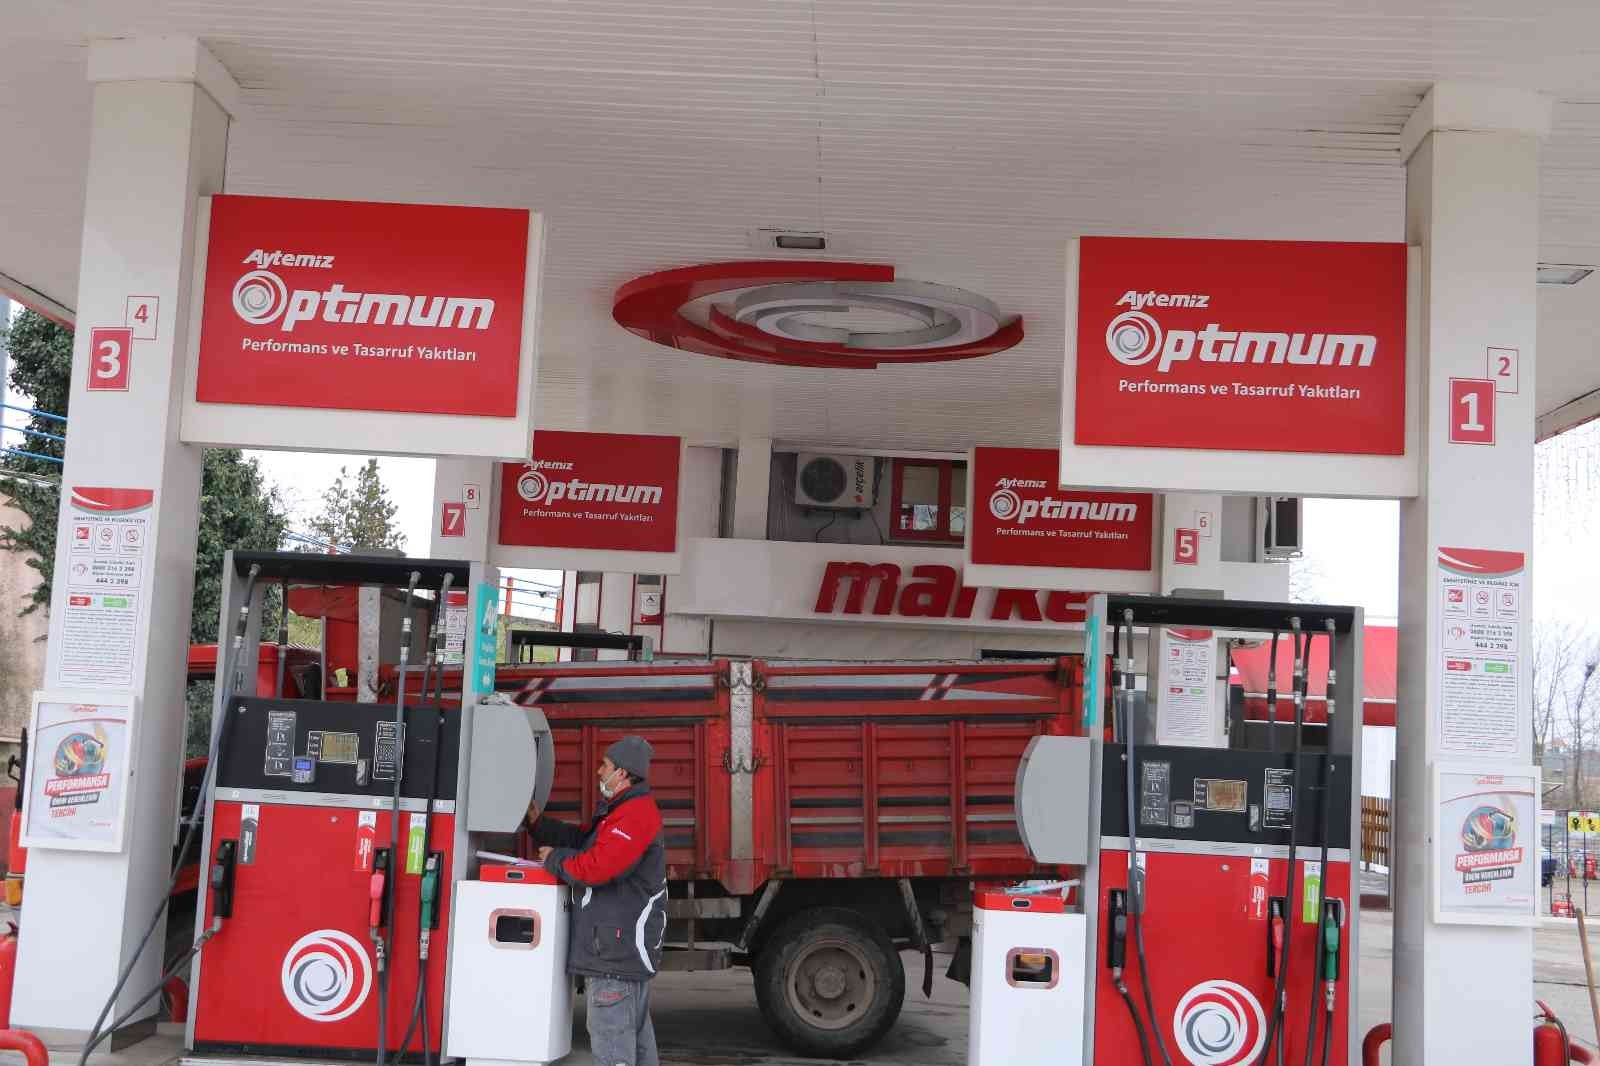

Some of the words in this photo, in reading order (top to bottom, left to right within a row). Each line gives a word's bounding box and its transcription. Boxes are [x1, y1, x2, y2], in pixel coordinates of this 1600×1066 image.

[242, 248, 335, 270] Aytemiz
[232, 270, 495, 332] Optimum
[1115, 290, 1210, 310] Aytemiz
[134, 304, 148, 323] 4
[242, 338, 328, 354] Performans
[332, 346, 349, 355] ve
[353, 343, 414, 358] Tasarruf
[417, 346, 477, 361] Yakıtları
[1106, 311, 1377, 373] Optimum
[96, 340, 121, 379] 3
[1498, 356, 1511, 376] 2
[1119, 380, 1206, 394] Performans
[1211, 385, 1229, 395] ve
[1232, 383, 1295, 397] Tasarruf
[1298, 384, 1360, 399] Yakıtları
[1461, 392, 1485, 431] 1
[467, 489, 475, 500] 8
[517, 470, 663, 505] Optimum
[523, 508, 570, 518] Performans
[585, 511, 617, 521] Tasarruf
[989, 489, 1138, 523] Optimum
[447, 509, 461, 530] 7
[1199, 516, 1207, 528] 6
[996, 527, 1045, 537] Performans
[1059, 529, 1093, 539] Tasarruf
[1179, 535, 1194, 558] 5
[1457, 849, 1520, 867] PERFORMANSA
